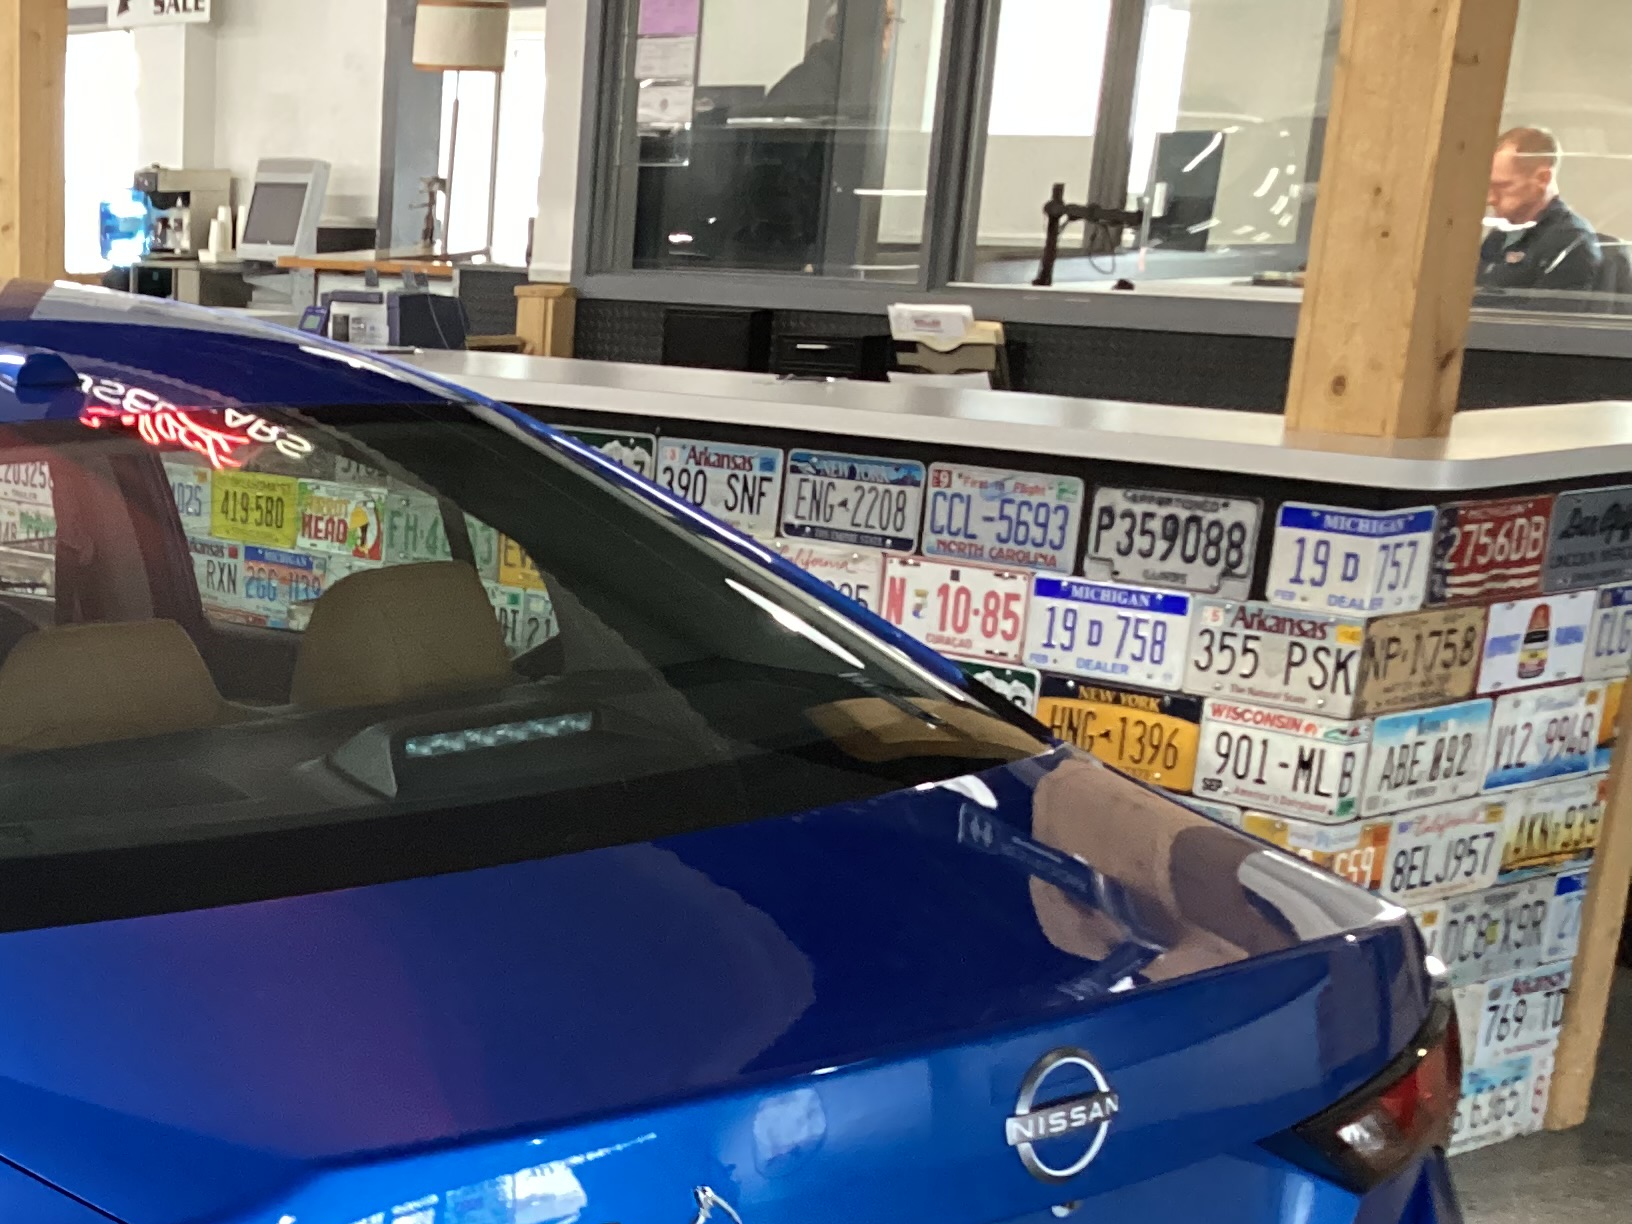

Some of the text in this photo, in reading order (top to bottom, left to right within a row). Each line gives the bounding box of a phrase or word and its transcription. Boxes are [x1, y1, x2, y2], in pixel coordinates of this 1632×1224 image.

[686, 445, 754, 472] Arkansas
[724, 473, 773, 515] SNF
[301, 512, 349, 545] HEAD
[1094, 505, 1247, 570] P359088
[936, 539, 984, 558] NORTH
[1289, 537, 1331, 587] 19
[1375, 540, 1419, 594] 757
[1071, 585, 1150, 608] MICHIGAN
[1042, 606, 1077, 652] 19
[1116, 614, 1167, 666] 758
[1230, 605, 1330, 641] Arkansas
[1076, 657, 1129, 676] DEALER
[1194, 628, 1356, 696] 355 PSK
[1211, 702, 1303, 730] WISCONSIN
[1012, 1094, 1119, 1141] NISSAN
